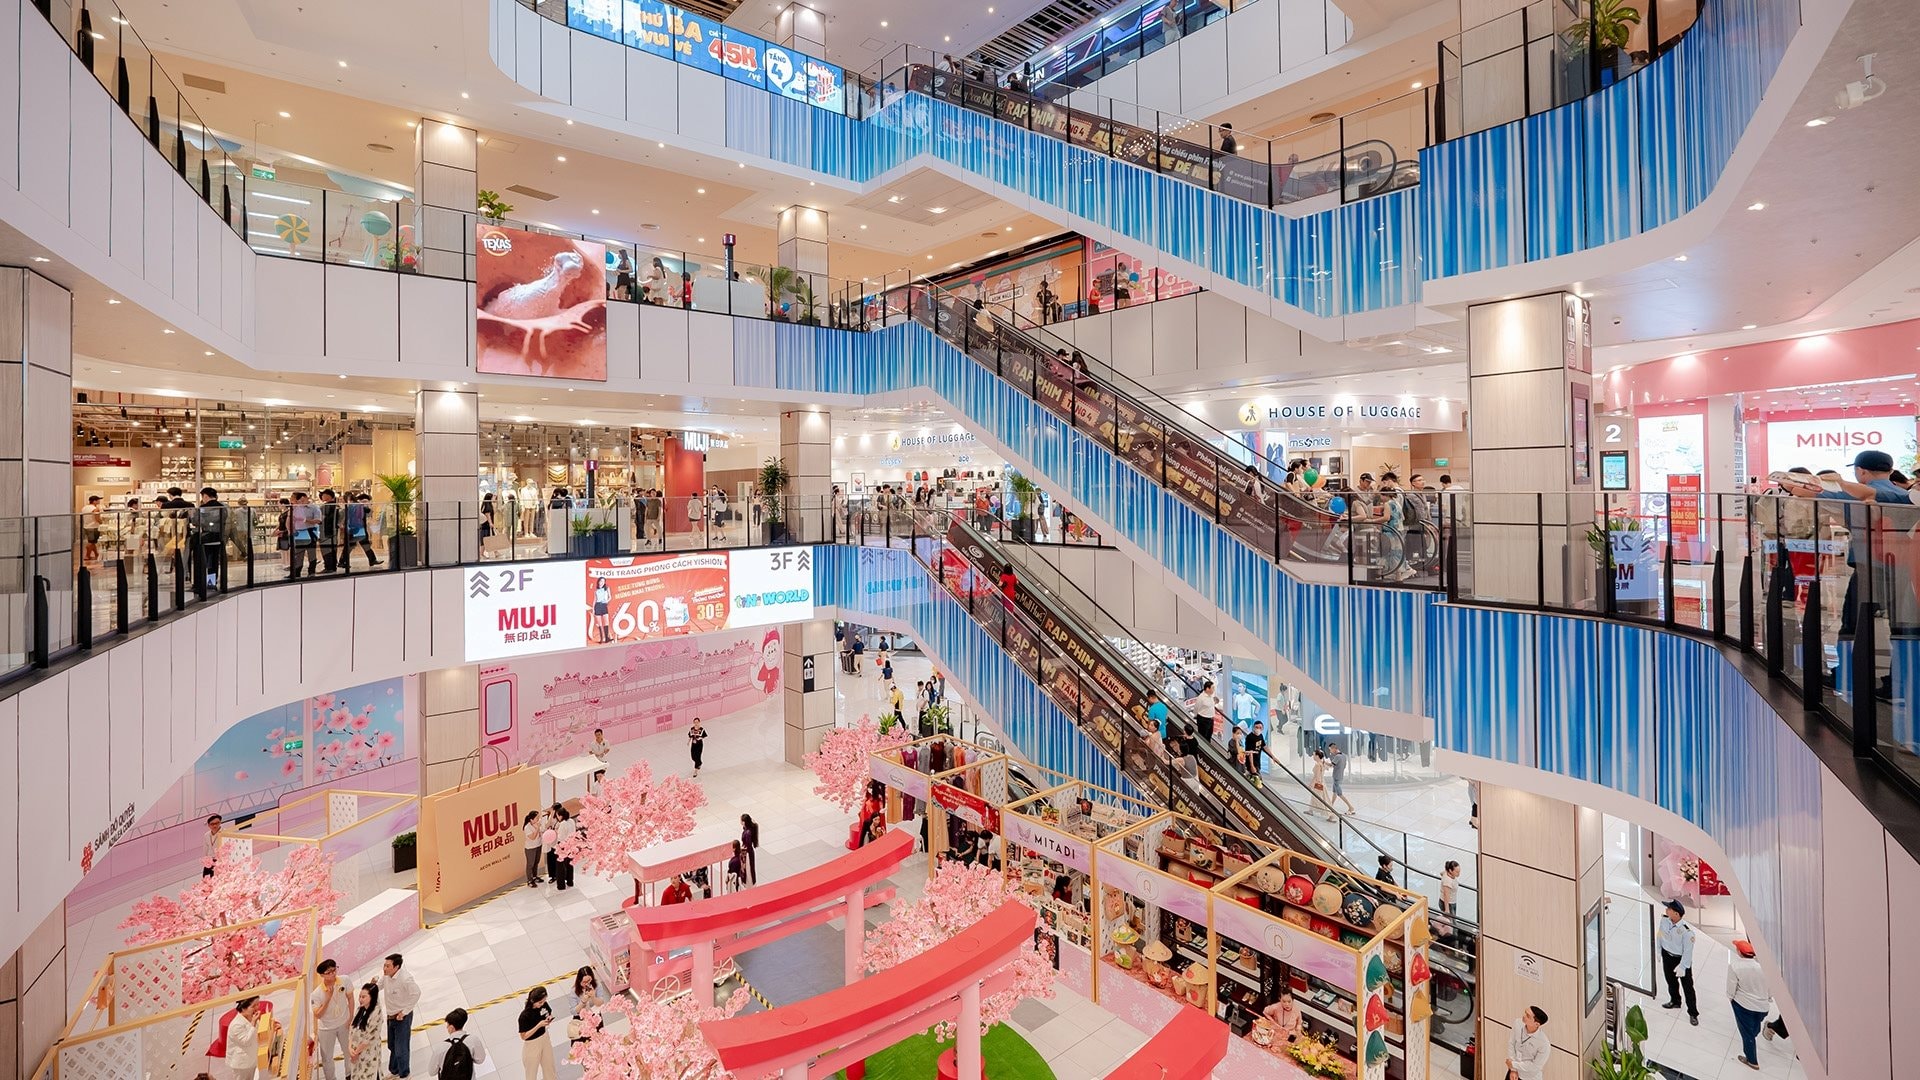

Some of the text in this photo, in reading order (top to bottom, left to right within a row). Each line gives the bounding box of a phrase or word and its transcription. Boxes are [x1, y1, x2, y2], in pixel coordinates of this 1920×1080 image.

[668, 14, 703, 43] BA
[641, 29, 670, 48] VUI
[708, 37, 756, 70] 45K
[771, 63, 784, 80] 4
[1203, 156, 1226, 171] Fmily
[481, 238, 512, 251] TEXAS
[1036, 377, 1063, 402] PHIM
[1269, 405, 1421, 419] HOUSE OF LUGGAGE
[684, 431, 709, 451] MUJI
[902, 432, 976, 446] HOUSE OF LUGGAGE
[1605, 424, 1621, 443] 2
[1796, 431, 1883, 448] MINISO
[617, 567, 643, 576] TRANG
[644, 564, 671, 574] PHONG
[694, 558, 723, 567] YISHION
[770, 552, 793, 571] 3F
[500, 568, 534, 593] 2F
[762, 589, 810, 606] WORLD
[498, 604, 557, 631] MUJI
[504, 629, 551, 644] 無印良品
[1006, 624, 1030, 648] RẠP
[1044, 617, 1096, 671] RẠP PHIM
[1226, 783, 1244, 802] phim
[1243, 796, 1265, 822] Family
[463, 802, 519, 847] MUJI
[470, 831, 515, 859] 無印良品
[1034, 834, 1075, 860] MITADI
